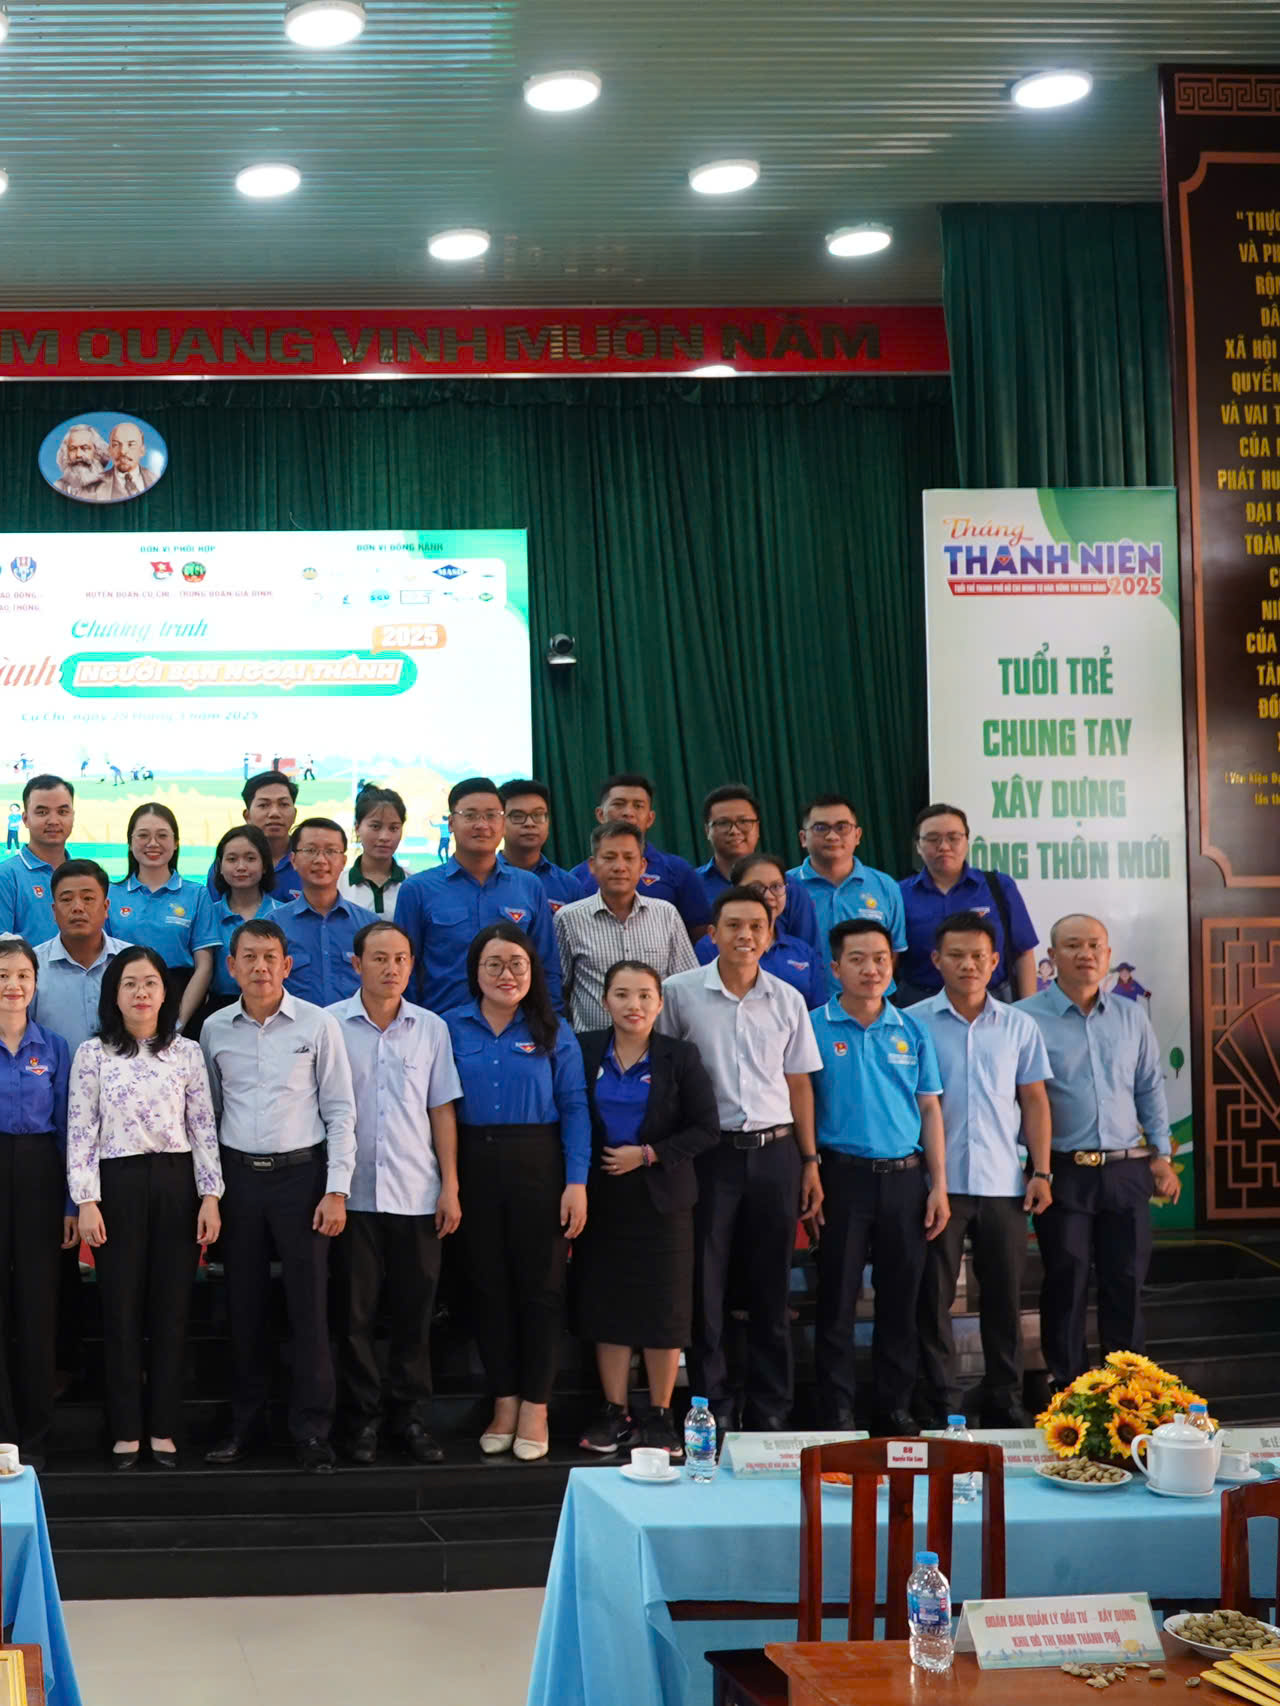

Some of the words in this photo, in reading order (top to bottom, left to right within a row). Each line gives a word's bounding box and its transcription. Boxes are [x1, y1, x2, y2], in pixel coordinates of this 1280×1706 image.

[1238, 237, 1259, 263] VÀ
[78, 327, 316, 366] QUANG
[332, 327, 487, 364] VINH
[504, 318, 704, 363] MUÔN
[722, 316, 881, 363] NĂM
[1224, 334, 1247, 360] XÃ
[1252, 334, 1277, 364] HỘI
[1220, 400, 1240, 425] VÀ
[1244, 404, 1268, 425] VAI
[1239, 431, 1271, 458] CỦA
[1217, 464, 1255, 490] PHÁT
[1245, 501, 1272, 527] ĐẠI
[943, 518, 1034, 546] Tháng
[944, 544, 1069, 575] THANH
[1080, 538, 1161, 575] NIÊN
[1108, 577, 1161, 595] 2025
[381, 625, 439, 648] 2025
[1246, 626, 1277, 653] CỦA
[78, 655, 162, 688] NGƯỜI
[166, 660, 220, 690] BẠN
[223, 660, 305, 690] NGOẠI
[308, 654, 398, 687] THÀNH
[998, 641, 1057, 696] TUỔI
[1066, 646, 1113, 695] TRẺ
[983, 718, 1076, 757] CHUNG
[1084, 718, 1132, 757] TAY
[992, 774, 1042, 818] XÂY
[1052, 776, 1127, 827] DỰNG
[969, 836, 1029, 879] ÔNG
[1037, 836, 1109, 879] THÔN
[1118, 834, 1170, 879] MỚI
[1008, 1613, 1026, 1628] BAN
